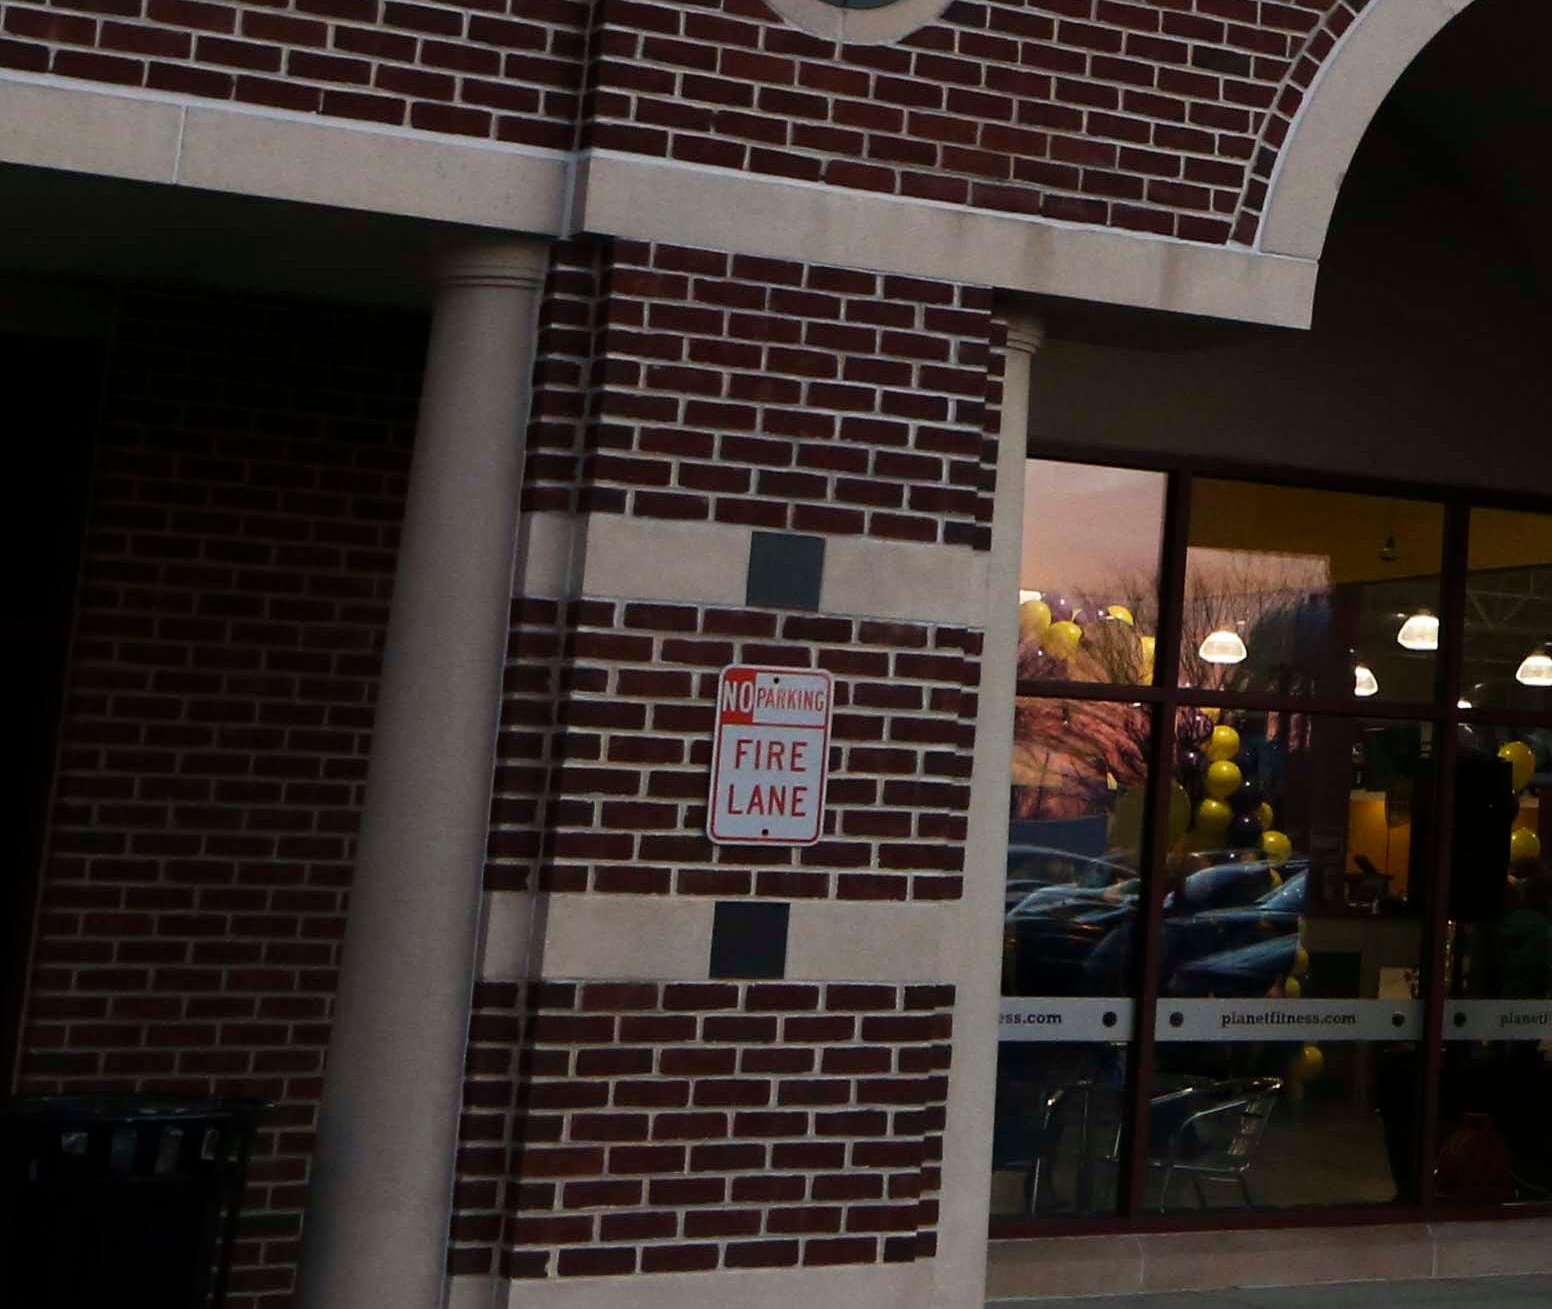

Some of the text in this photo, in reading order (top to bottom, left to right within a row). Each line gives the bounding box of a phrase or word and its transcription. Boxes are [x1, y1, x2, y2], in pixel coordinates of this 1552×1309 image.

[723, 680, 826, 713] NO PARKING
[735, 739, 809, 772] FIRE
[728, 784, 808, 817] LANE
[1222, 1010, 1357, 1027] planetfitness.com
